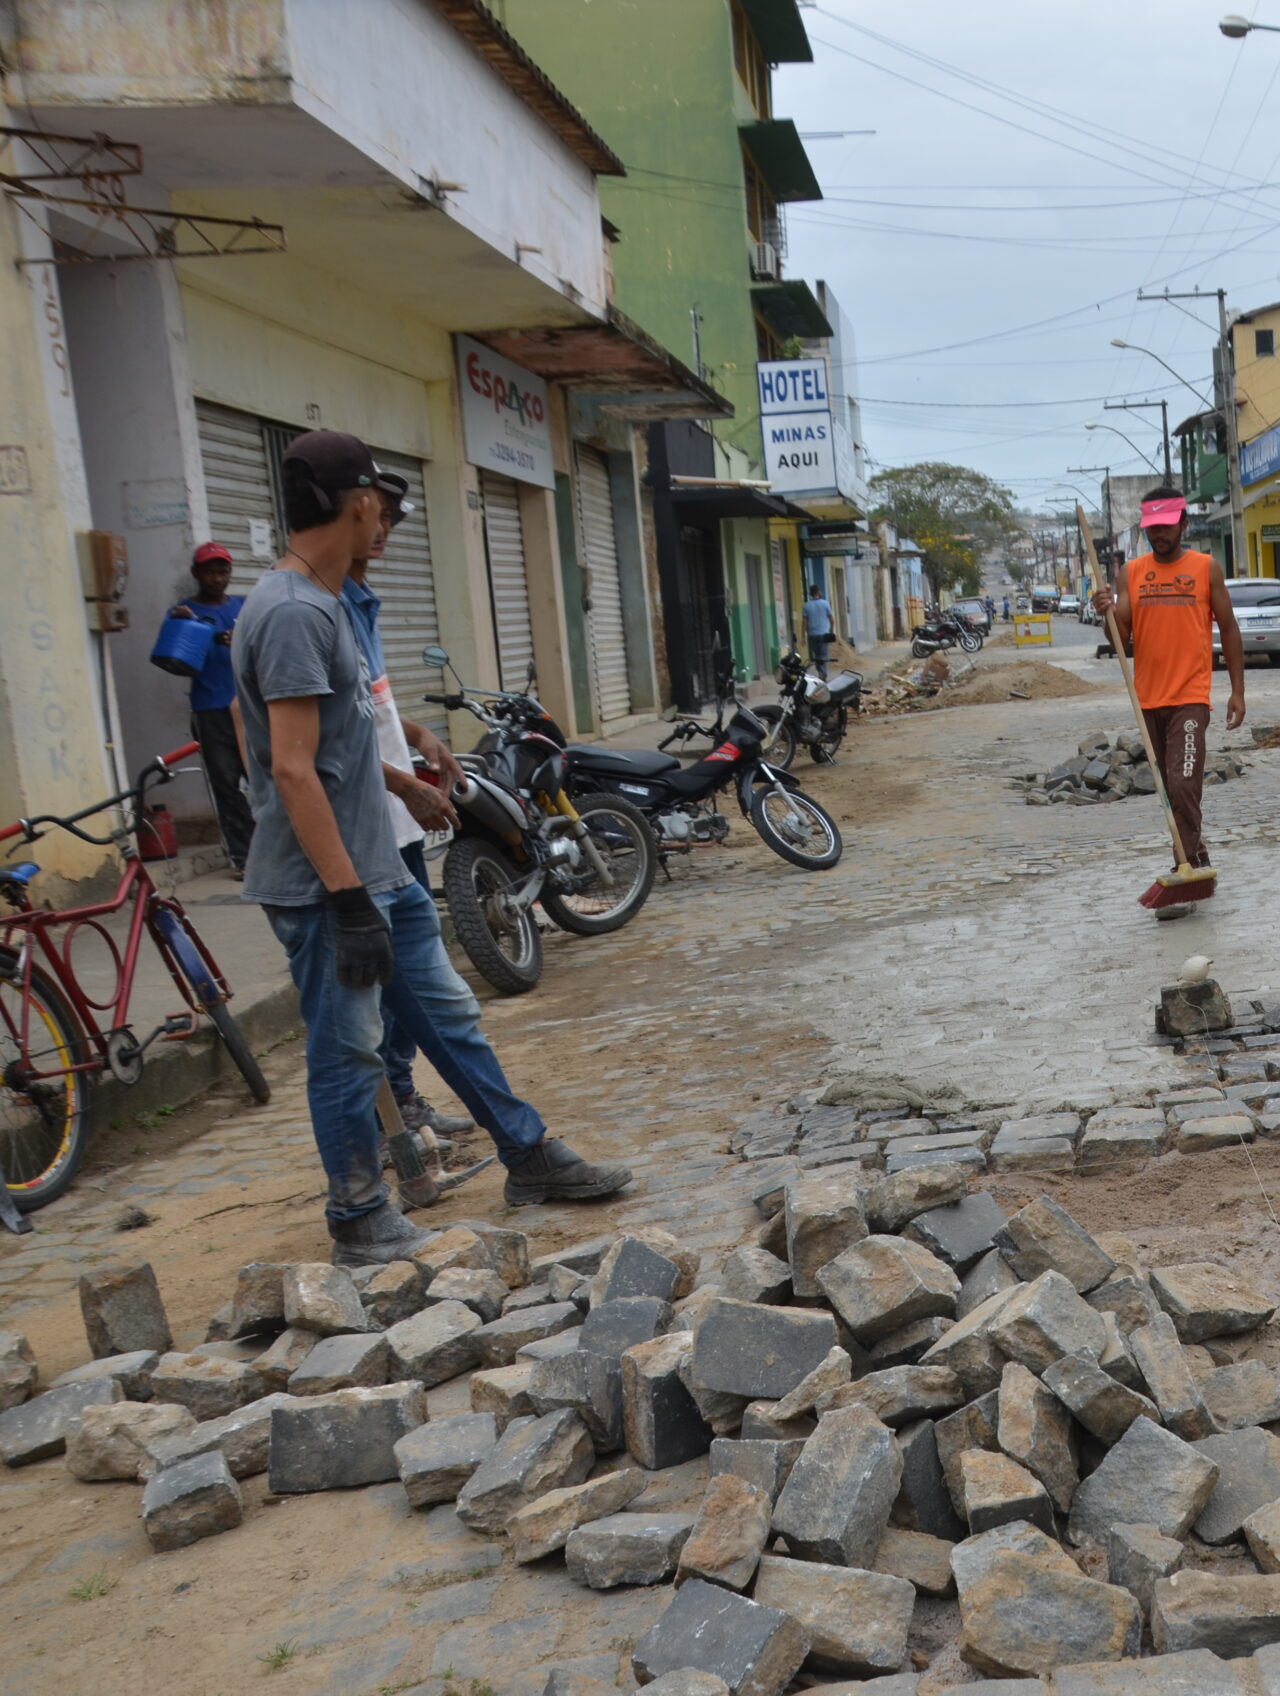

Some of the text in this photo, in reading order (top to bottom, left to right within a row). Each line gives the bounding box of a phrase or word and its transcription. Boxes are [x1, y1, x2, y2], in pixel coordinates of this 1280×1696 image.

[760, 369, 826, 404] HOTEL
[771, 425, 827, 444] MINAS
[778, 451, 819, 470] AQUI
[1183, 733, 1197, 778] adidas
